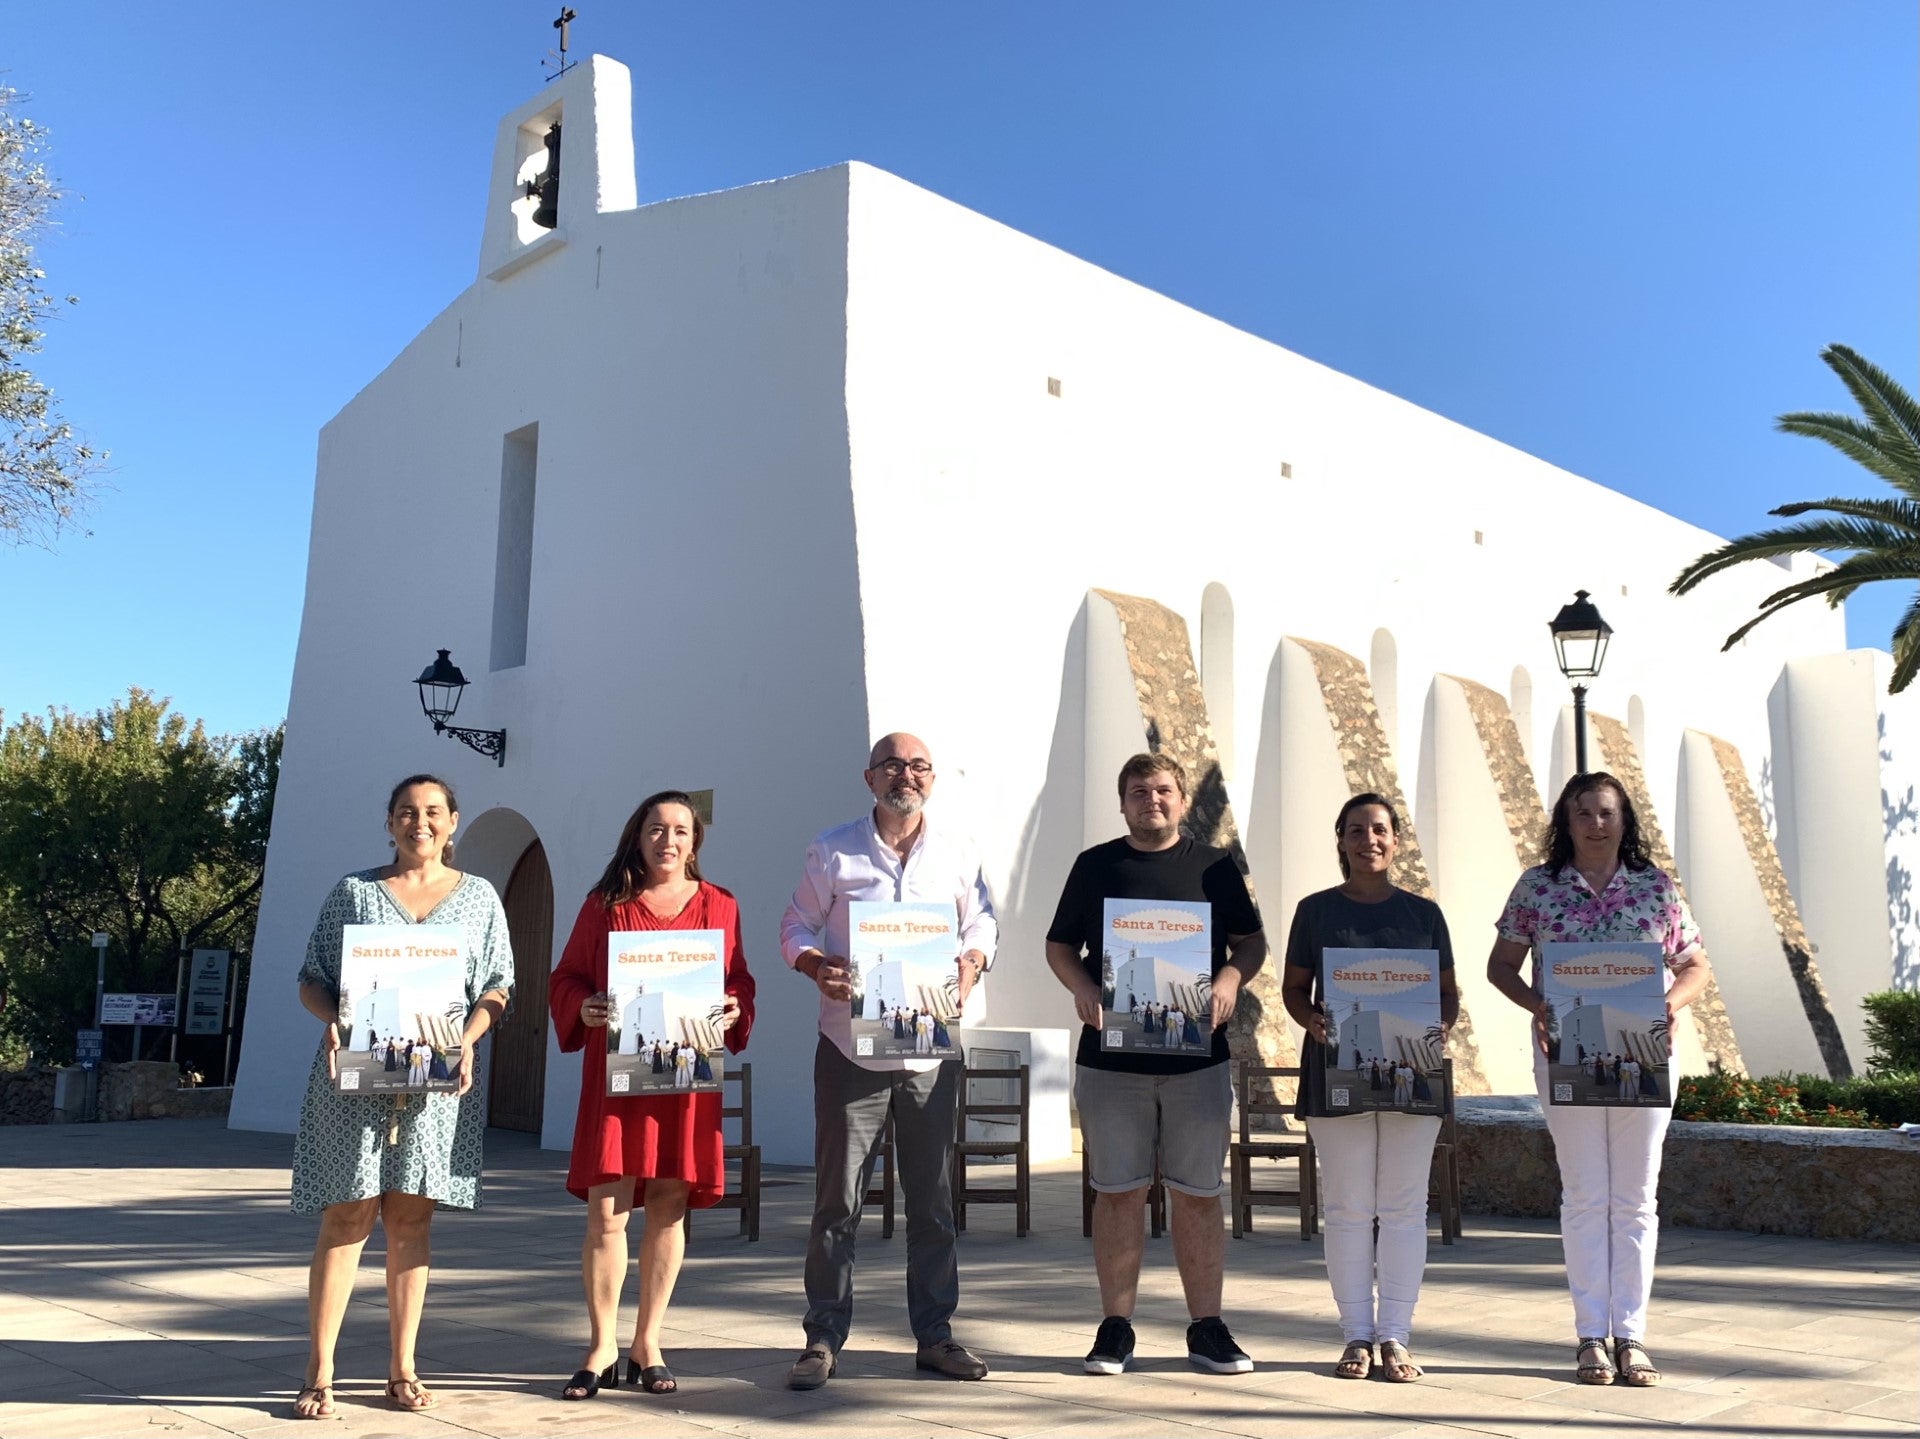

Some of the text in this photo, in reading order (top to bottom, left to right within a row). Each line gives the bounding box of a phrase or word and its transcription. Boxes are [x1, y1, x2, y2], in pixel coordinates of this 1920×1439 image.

[859, 922, 950, 933] Santa Teresa
[1112, 918, 1204, 932] Santa Teresa
[352, 946, 457, 957] Santa Teresa
[618, 951, 717, 963] Santa Teresa
[1552, 964, 1656, 975] Santa Teresa
[1333, 970, 1432, 982] Santa Teresa
